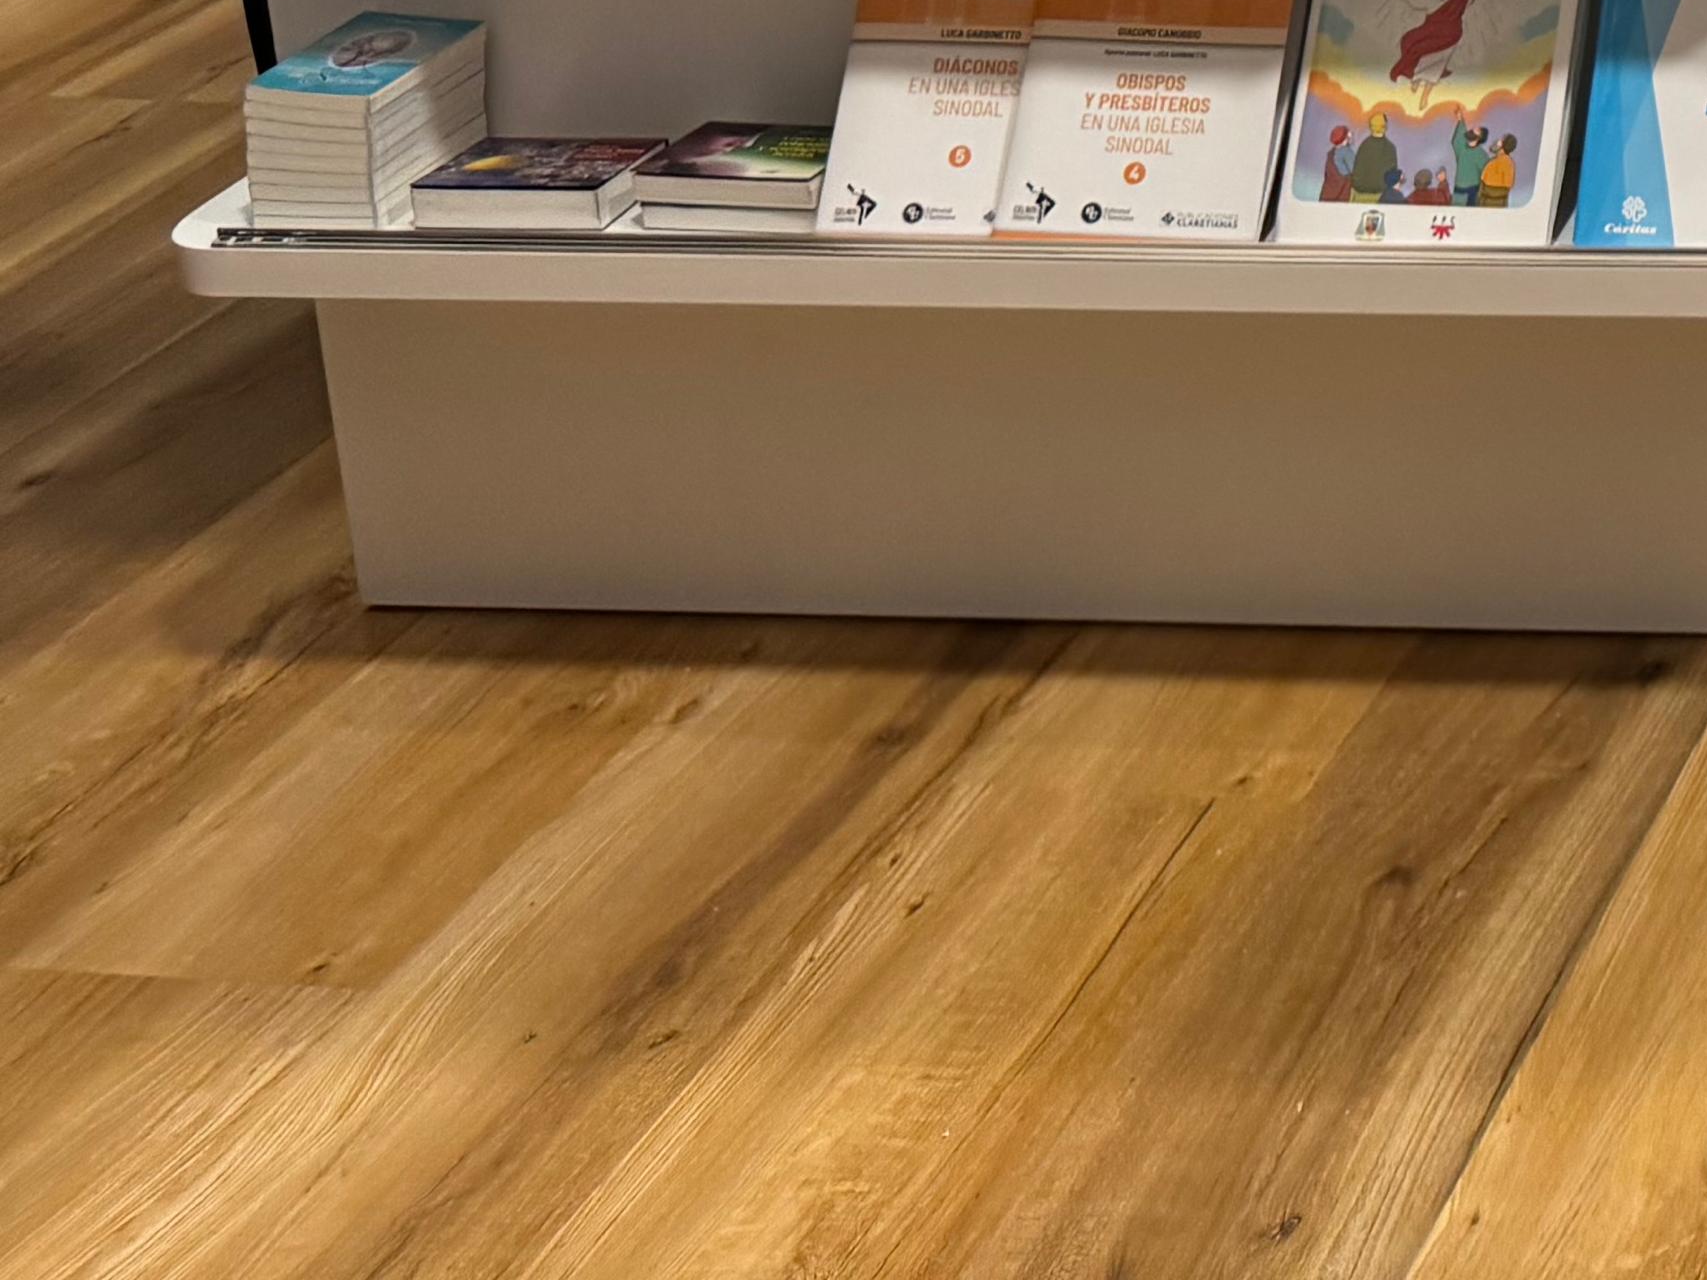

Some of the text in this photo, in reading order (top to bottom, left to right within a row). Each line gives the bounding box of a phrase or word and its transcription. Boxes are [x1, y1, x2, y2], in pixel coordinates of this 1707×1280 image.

[933, 55, 1020, 75] DIÁCONOS
[1116, 72, 1186, 91] OBISPOS
[933, 99, 1004, 118] SINODAL
[1085, 91, 1211, 114] Y PRESBÍTEROS
[1081, 113, 1206, 135] EN UNA IGLESIA
[1104, 135, 1174, 156] SINODAL
